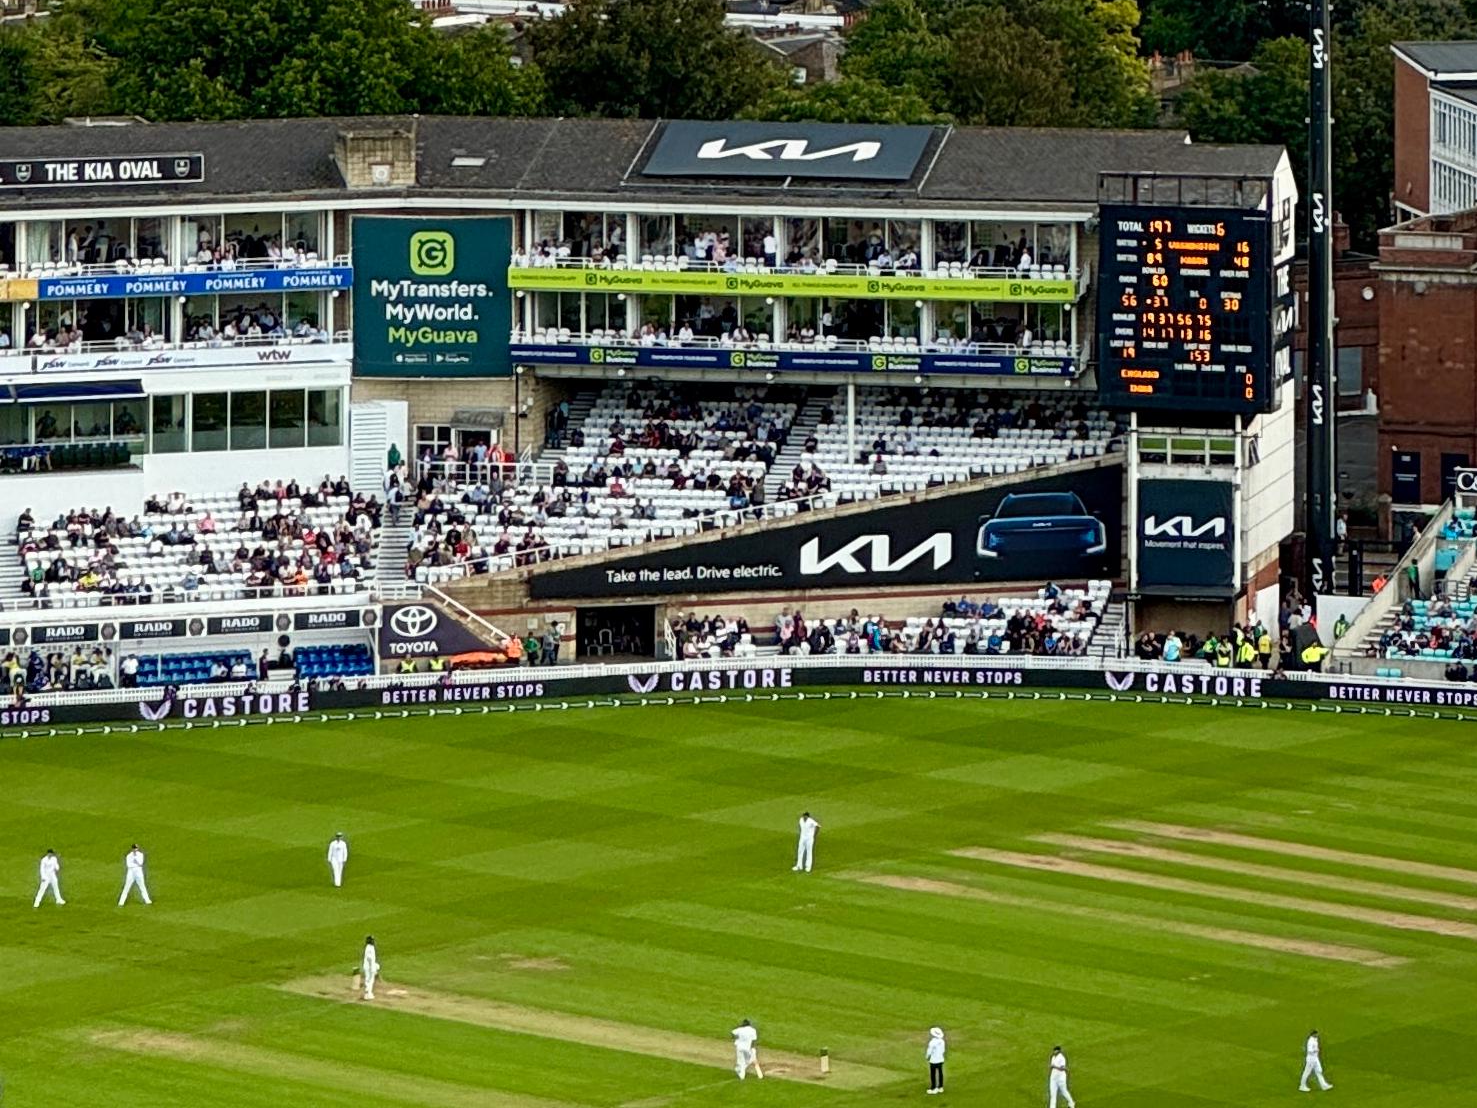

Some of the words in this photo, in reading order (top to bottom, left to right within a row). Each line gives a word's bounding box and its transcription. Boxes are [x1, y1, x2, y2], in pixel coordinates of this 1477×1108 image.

[45, 163, 78, 181] THE
[84, 162, 114, 180] KIA
[119, 160, 163, 179] OVAL
[1117, 221, 1144, 232] TOTAL
[1150, 220, 1172, 233] 197
[1187, 224, 1216, 235] WICKETS
[1216, 223, 1225, 237] 6
[126, 280, 187, 293] POMMERY
[206, 277, 266, 290] POMMERY
[283, 274, 343, 287] POMMERY
[47, 283, 109, 296] POMMERY
[371, 280, 493, 301] MyTransfers.
[1121, 295, 1137, 307] 56
[1223, 299, 1240, 311] 30
[385, 303, 479, 324] MyWorld.
[1142, 313, 1155, 324] 19
[1159, 313, 1174, 325] 37
[1177, 313, 1193, 326] 56
[388, 327, 478, 347] MyGuava
[1142, 328, 1155, 338] 14
[257, 348, 292, 362] wtw
[1190, 350, 1210, 362] 153
[1145, 539, 1181, 548] Movement
[1182, 541, 1197, 549] that
[606, 569, 636, 583] Take
[638, 568, 660, 582] the
[662, 567, 694, 581] lead.
[697, 566, 731, 580] Drive
[733, 564, 783, 579] electric.
[221, 617, 260, 628] RADO
[308, 612, 346, 623] RADO
[46, 626, 85, 637] RADO
[134, 622, 173, 633] RADO
[389, 641, 439, 655] TOYOTA
[671, 668, 792, 691] CASTORE
[863, 669, 918, 684] BETTER
[923, 669, 970, 684] NEVER
[976, 670, 1022, 684] STOPS
[1145, 673, 1262, 698] CASTORE
[382, 689, 437, 704] BETTER
[443, 686, 490, 702] NEVER
[496, 683, 544, 698] STOPS
[1329, 685, 1382, 701] BETTER
[1386, 688, 1431, 704] NEVER
[183, 693, 310, 718] CASTORE
[0, 708, 50, 725] STOPS
